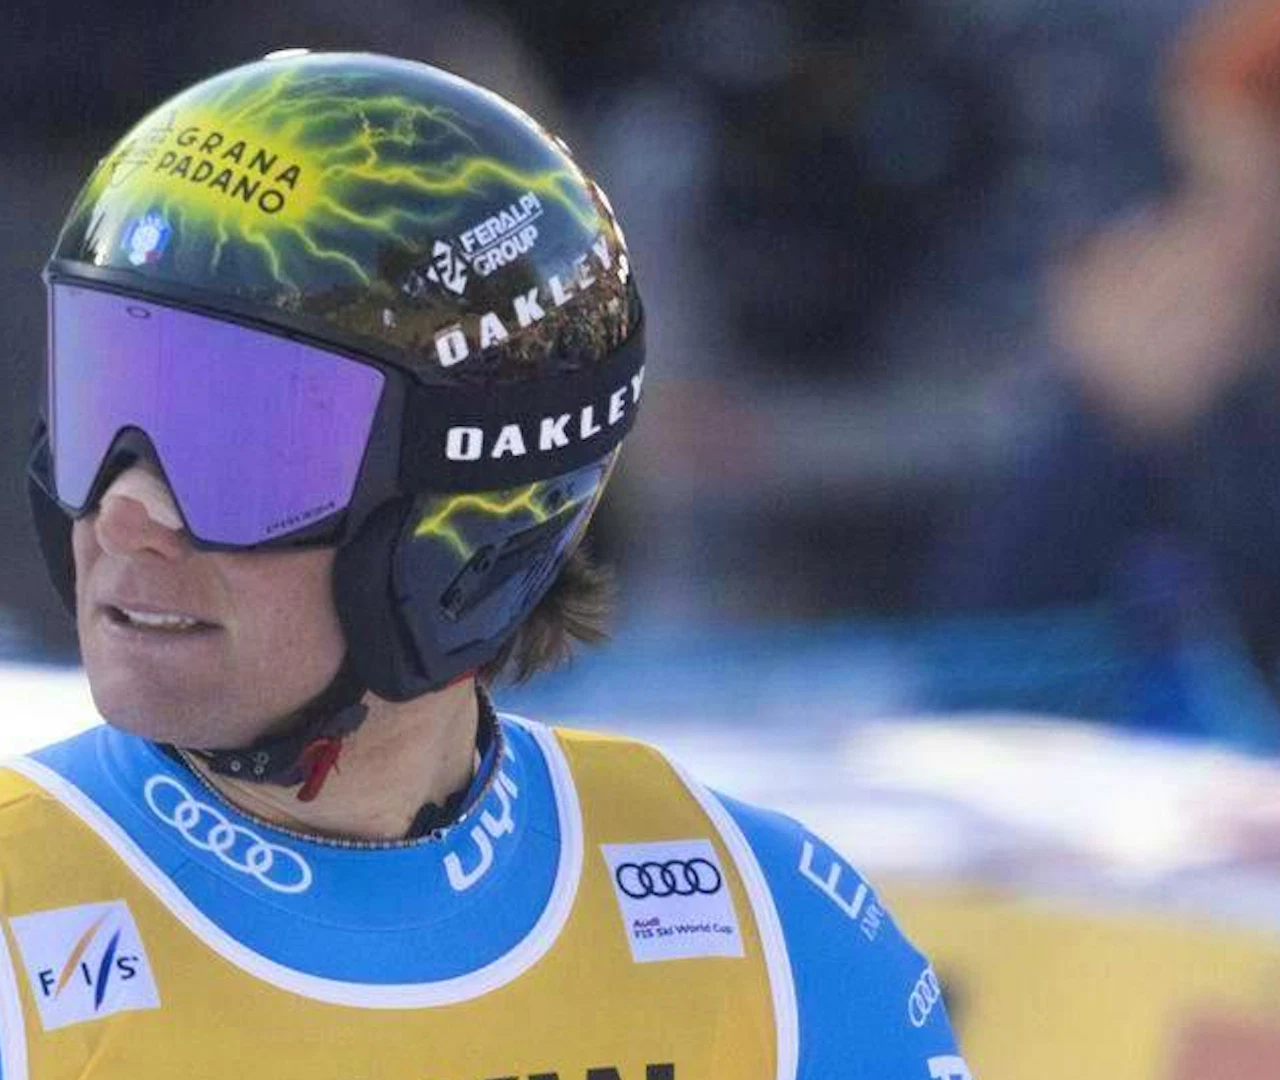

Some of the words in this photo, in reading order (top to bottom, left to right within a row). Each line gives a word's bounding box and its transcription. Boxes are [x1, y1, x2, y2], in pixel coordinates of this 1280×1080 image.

[154, 151, 285, 214] PADANO
[176, 127, 301, 190] GRANA
[460, 191, 541, 254] FERALPI
[473, 225, 539, 277] GROUP
[435, 236, 613, 368] OAKLEY
[445, 365, 645, 461] OAKLEY
[633, 917, 660, 928] Audi
[675, 923, 711, 934] World
